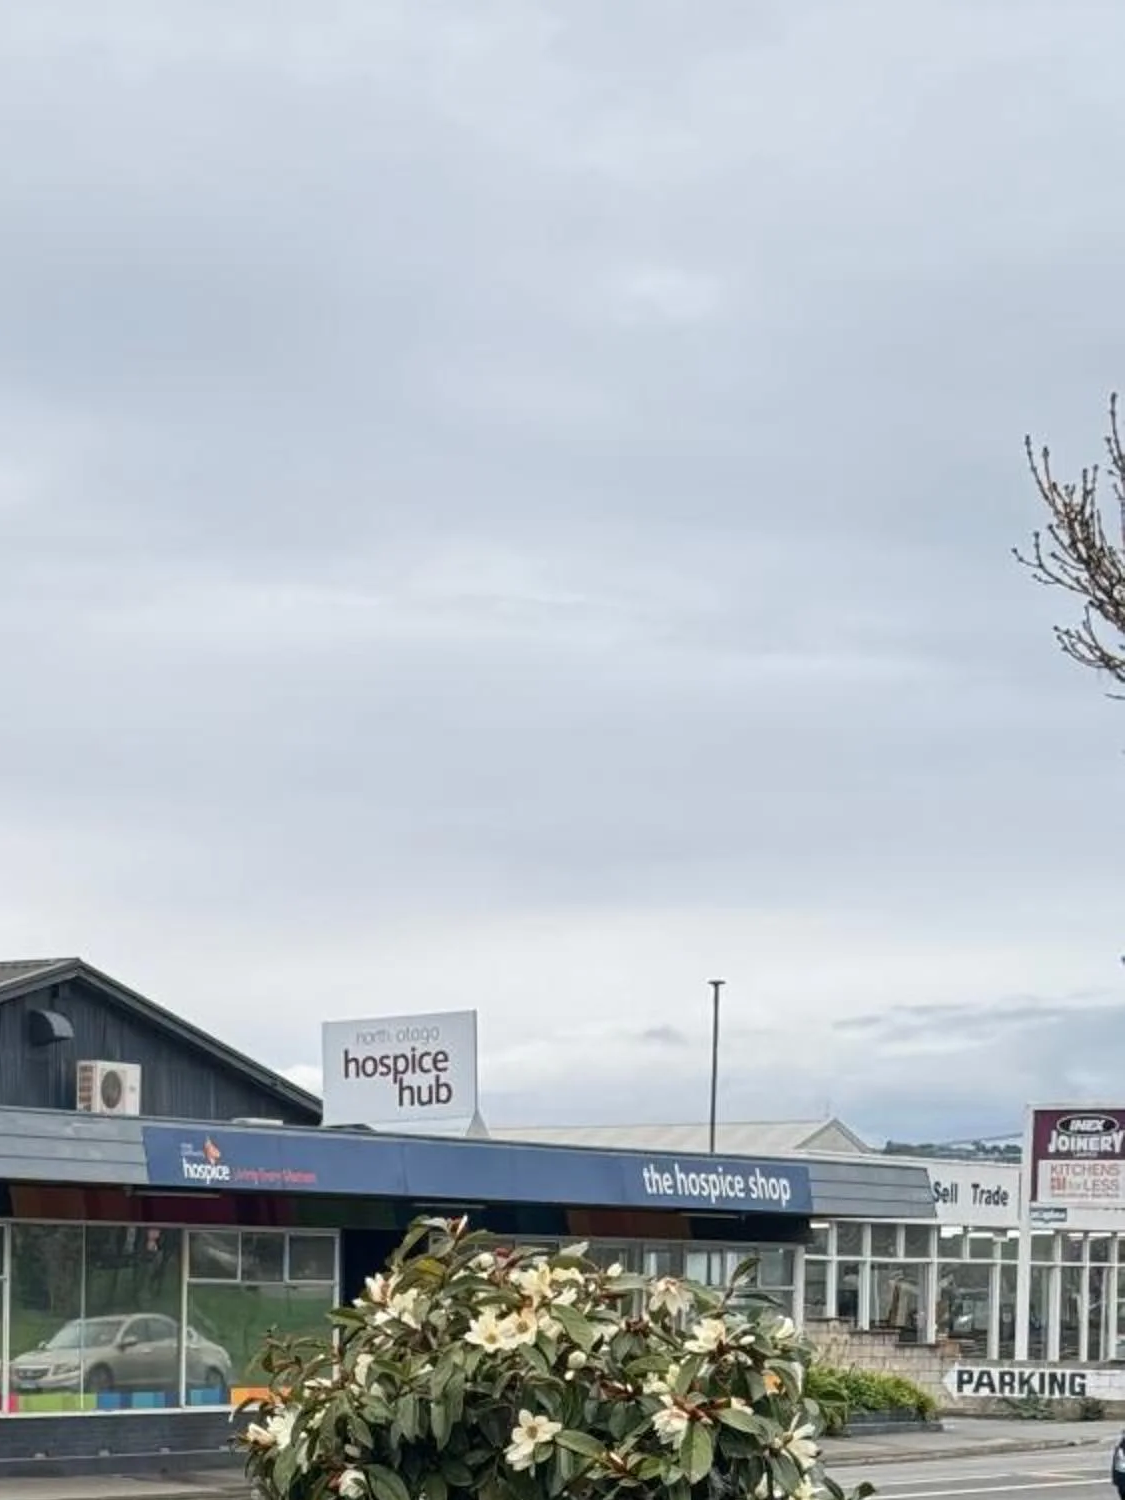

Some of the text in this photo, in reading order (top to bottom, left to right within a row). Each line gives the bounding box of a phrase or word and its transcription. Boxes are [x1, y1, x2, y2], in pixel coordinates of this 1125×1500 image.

[356, 1026, 440, 1045] north otago
[344, 1046, 449, 1084] hospice
[398, 1075, 453, 1107] hub
[1048, 1130, 1124, 1153] JOINERY
[182, 1158, 231, 1184] hospice
[1050, 1163, 1119, 1177] KITCHENS
[642, 1161, 791, 1208] the hospice shop
[934, 1181, 1009, 1206] Sell Trade
[956, 1369, 1087, 1397] PARKING
